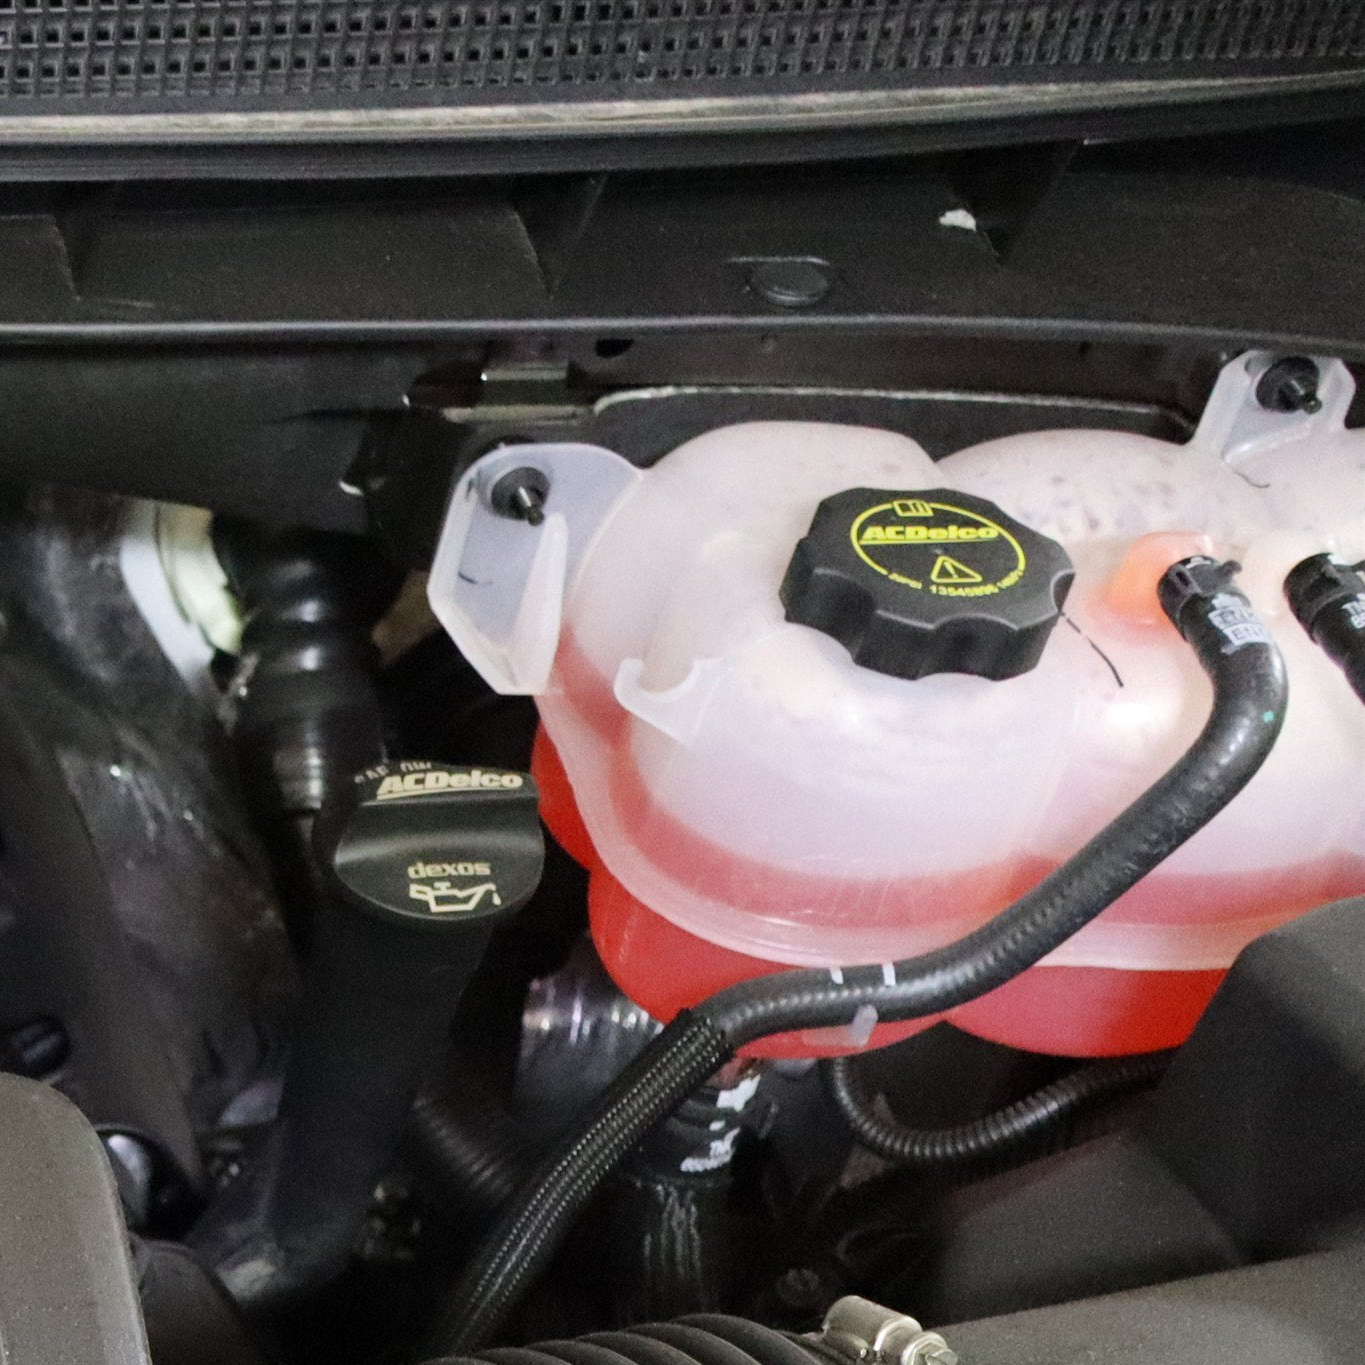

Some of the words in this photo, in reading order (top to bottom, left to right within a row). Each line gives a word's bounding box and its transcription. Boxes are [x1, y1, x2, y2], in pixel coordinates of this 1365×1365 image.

[860, 524, 1000, 541] ACDelco
[377, 769, 523, 797] ACDelco
[407, 861, 491, 879] dexos
